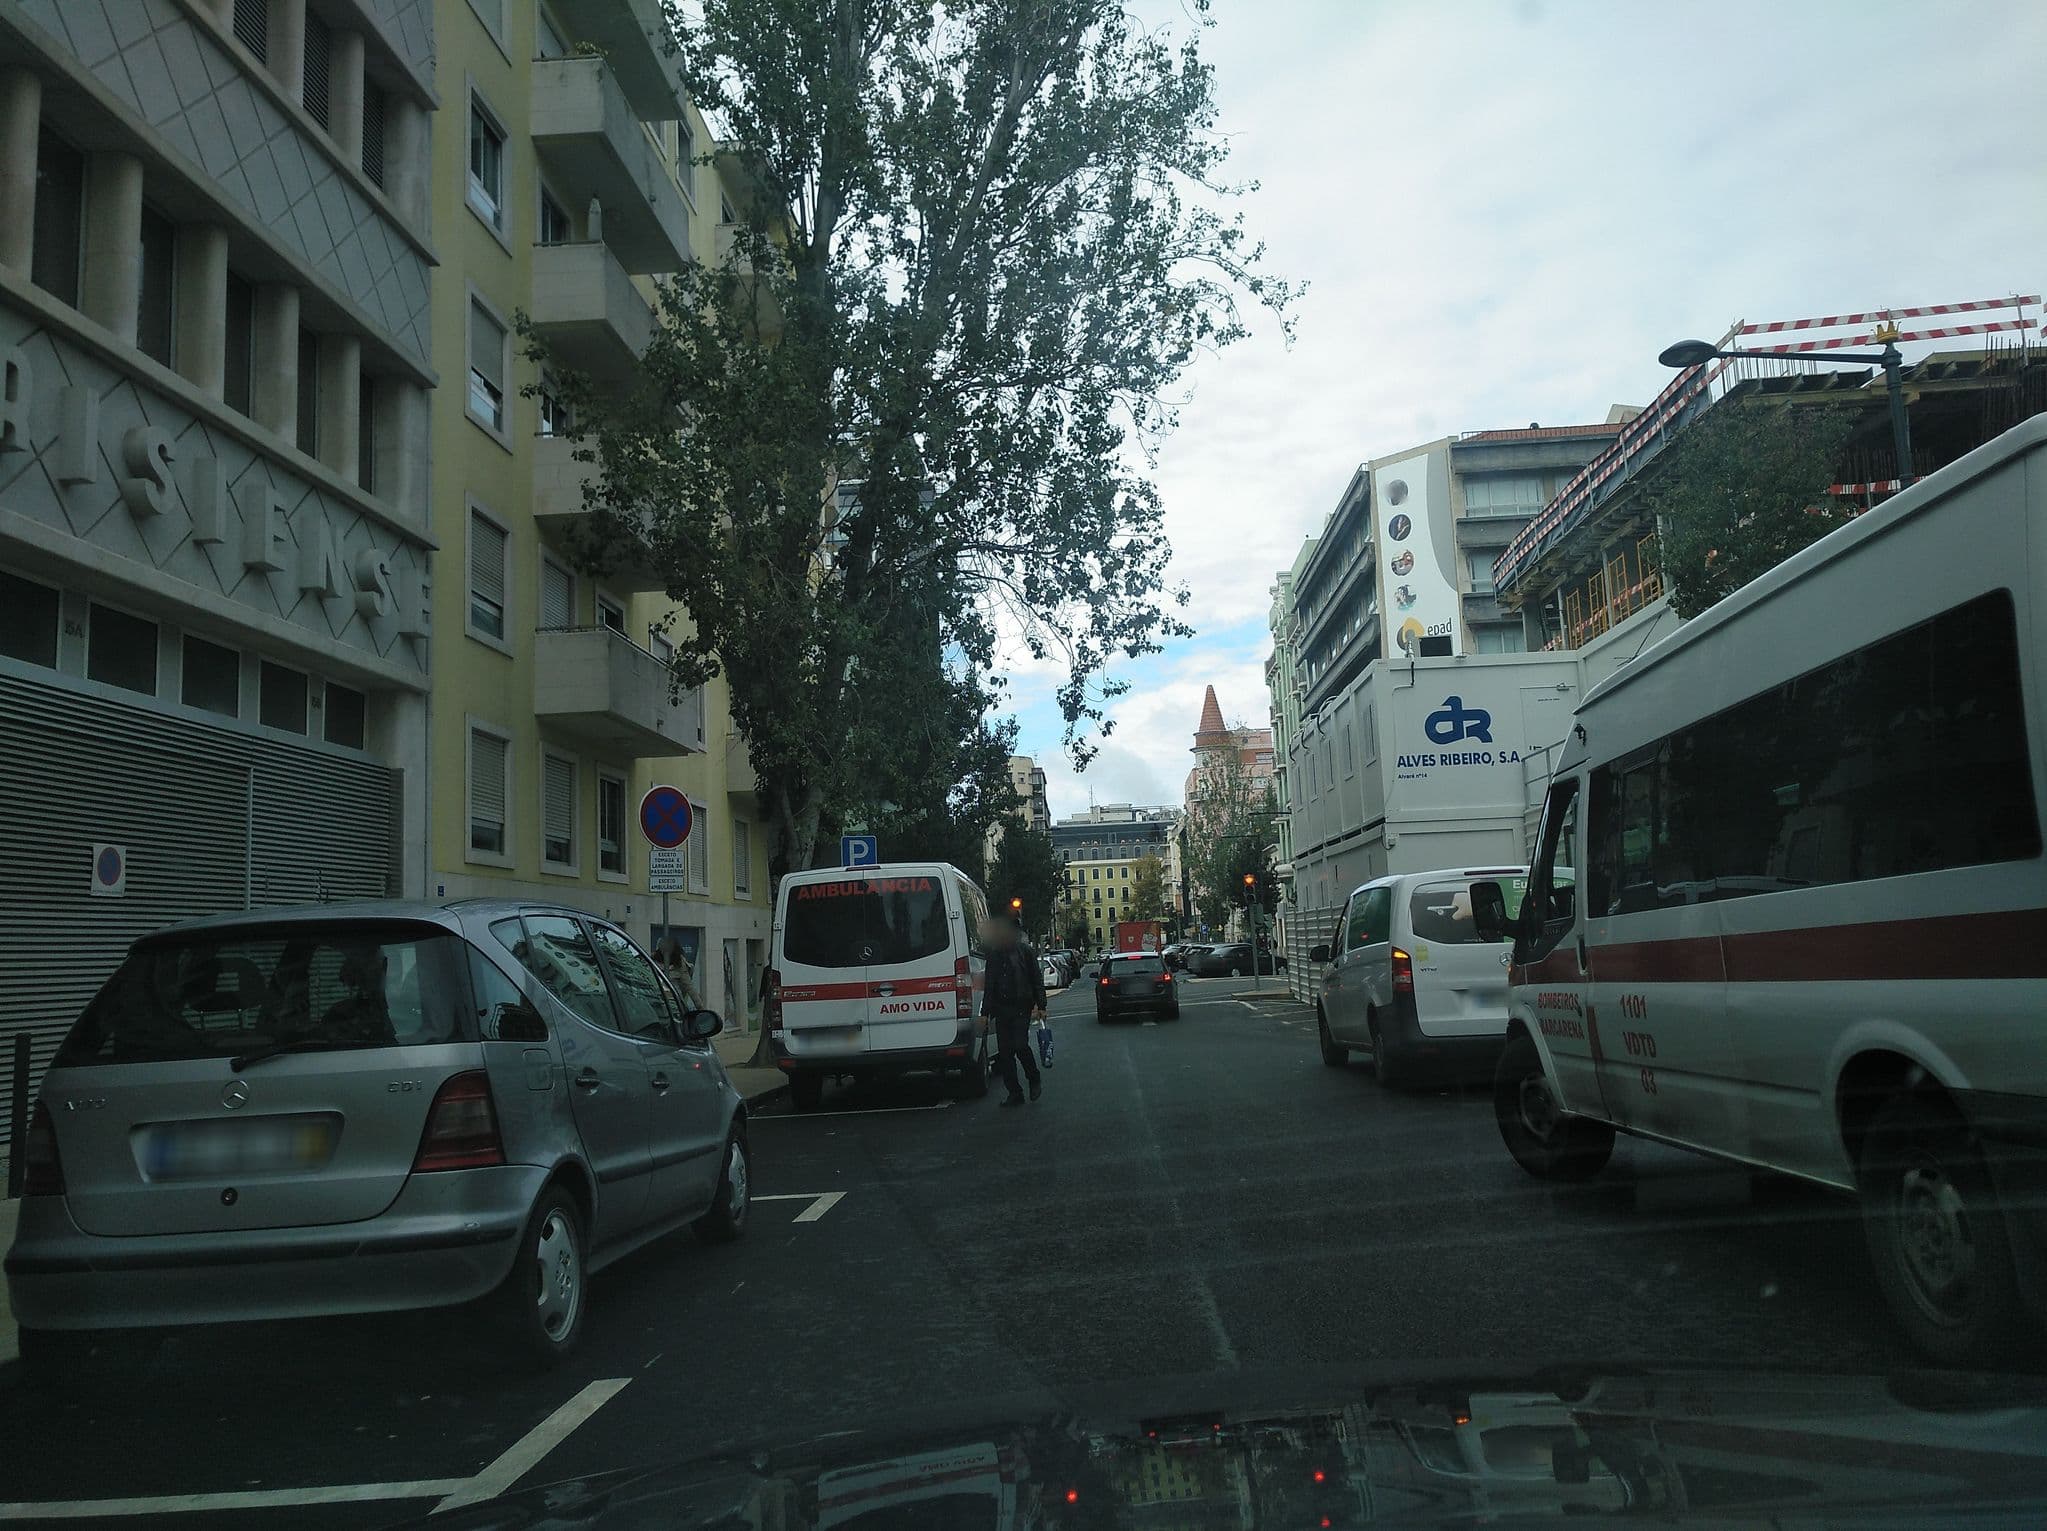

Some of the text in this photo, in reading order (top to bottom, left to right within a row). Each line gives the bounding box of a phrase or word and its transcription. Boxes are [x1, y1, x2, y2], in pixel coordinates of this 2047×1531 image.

[1428, 617, 1452, 636] epad
[1397, 755, 1436, 768] ALVES
[1440, 751, 1495, 767] RIBEIRO,
[849, 839, 869, 866] P
[880, 1000, 946, 1015] AMO VIDA
[1538, 992, 1580, 1010] BOMBEIROS
[1620, 994, 1648, 1019] 1101
[1623, 1031, 1657, 1058] VDTD
[1640, 1068, 1657, 1096] 03
